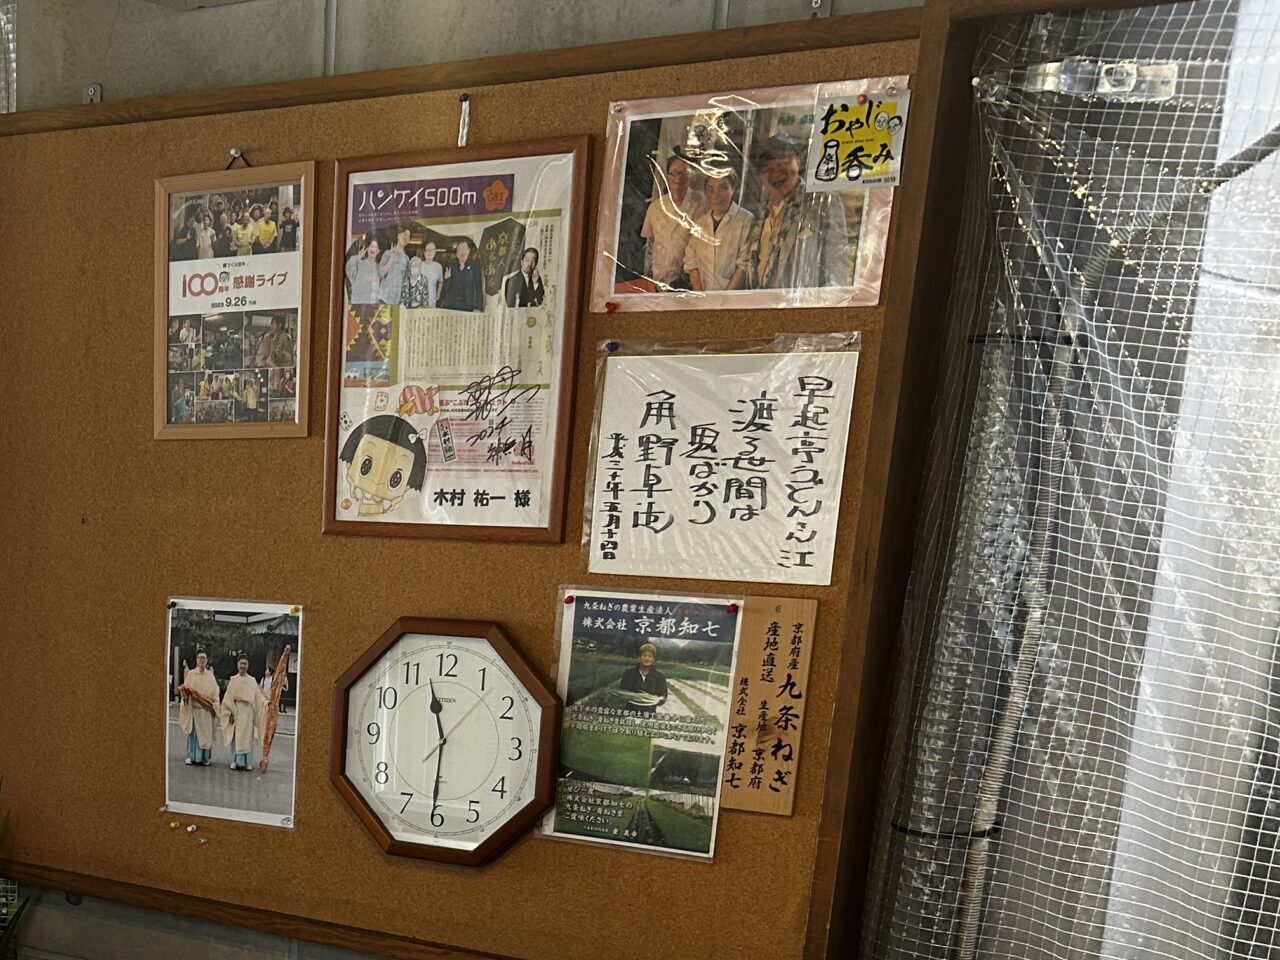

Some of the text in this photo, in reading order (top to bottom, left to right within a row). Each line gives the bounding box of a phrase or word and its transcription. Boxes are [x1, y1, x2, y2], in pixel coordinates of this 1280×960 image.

[821, 100, 882, 138] おやじ
[359, 187, 477, 211] ハンケイ500m
[182, 271, 288, 297] 100 感謝ライブ
[225, 296, 247, 307] 9.26
[722, 390, 778, 521] 渡る世間は
[434, 489, 531, 508] 木村 祐一 様
[583, 601, 672, 615] 九条ねぎの農業生産法人
[582, 615, 720, 637] 株式会社 京都知七
[403, 662, 420, 685] 11
[436, 653, 458, 677] 12
[478, 667, 487, 691] 1
[376, 686, 398, 709] 10
[499, 696, 514, 720] 2
[747, 621, 781, 790] 産地直送 生産地 京都府
[768, 622, 804, 792] 京都府産 九条ねぎ
[367, 722, 381, 745] 9
[725, 676, 749, 789] 株式会社 京都知七
[508, 737, 523, 760] 3
[375, 762, 389, 784] 8
[491, 776, 507, 799] 4
[400, 792, 413, 814] 7
[466, 800, 480, 823] 5
[430, 805, 445, 827] 6
